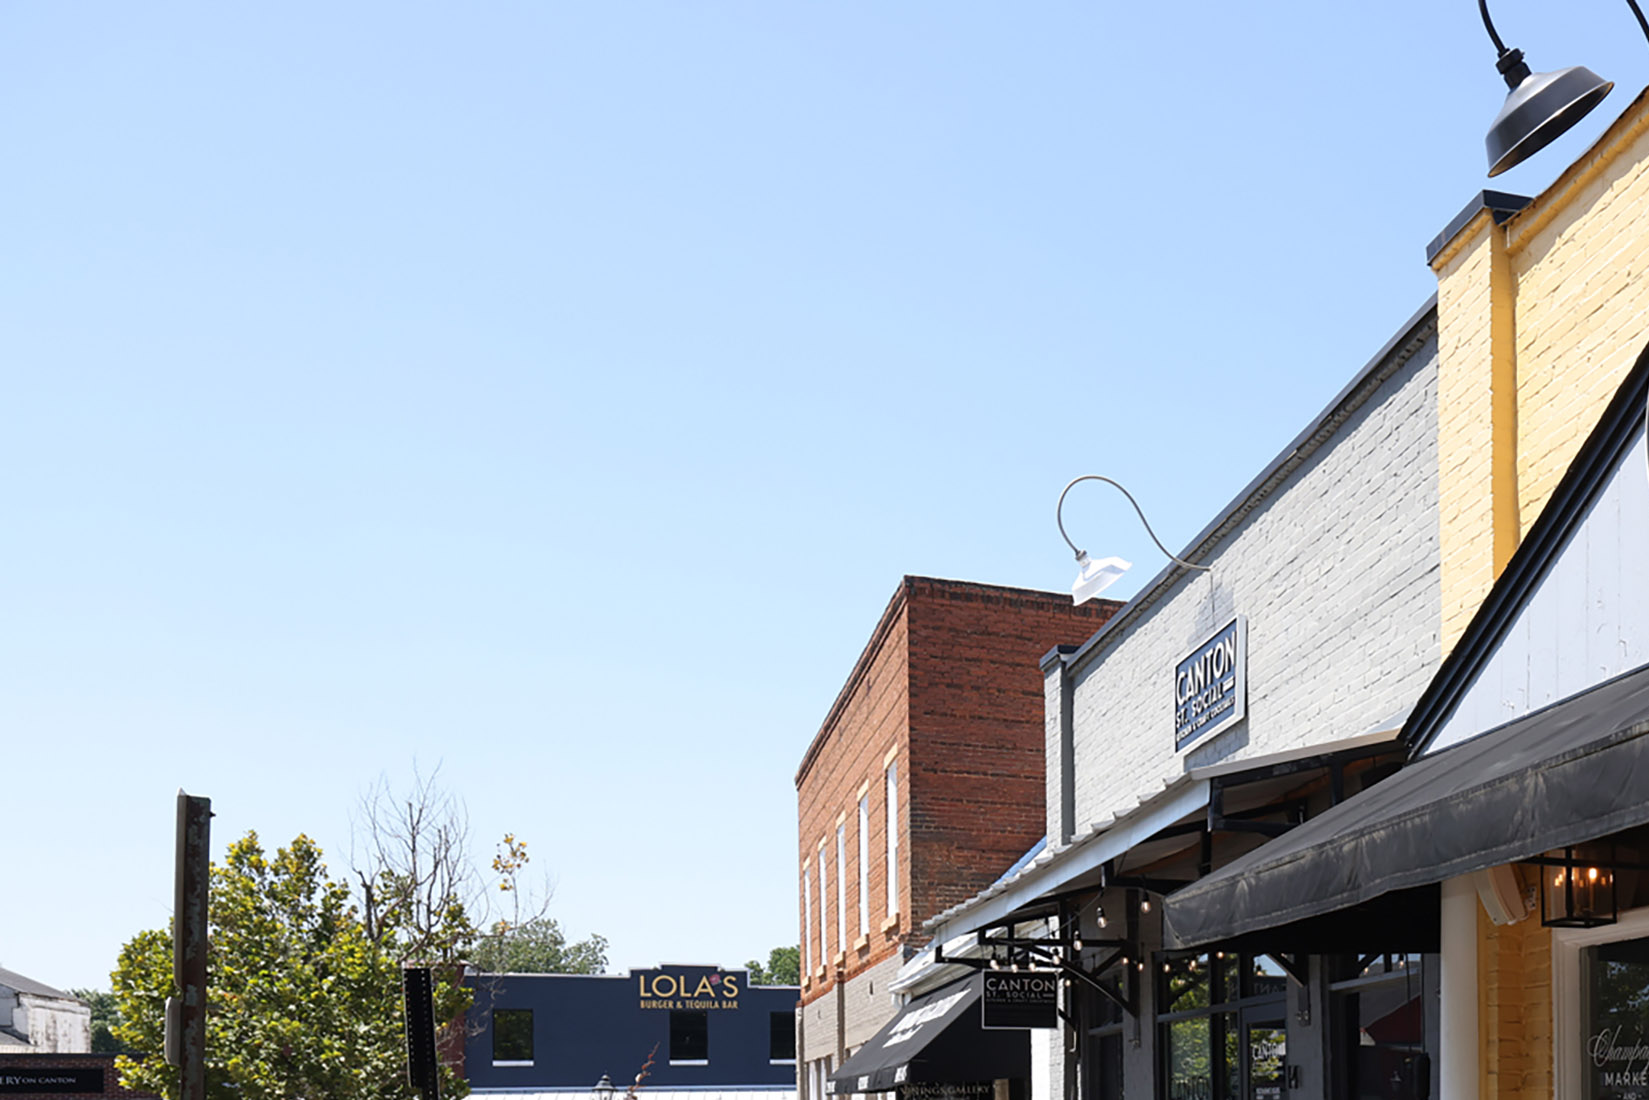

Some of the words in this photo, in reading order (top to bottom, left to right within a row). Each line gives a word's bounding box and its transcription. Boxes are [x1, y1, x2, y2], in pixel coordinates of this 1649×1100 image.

[1176, 631, 1235, 706] CANTON
[1192, 682, 1225, 718] SOCIAL
[986, 978, 1056, 992] CANTON
[1006, 991, 1042, 999] SOCIAL
[640, 1000, 674, 1009] BURGER
[686, 1000, 720, 1009] TEQUILA
[722, 1001, 738, 1009] BAR
[1623, 1093, 1637, 1100] AND
